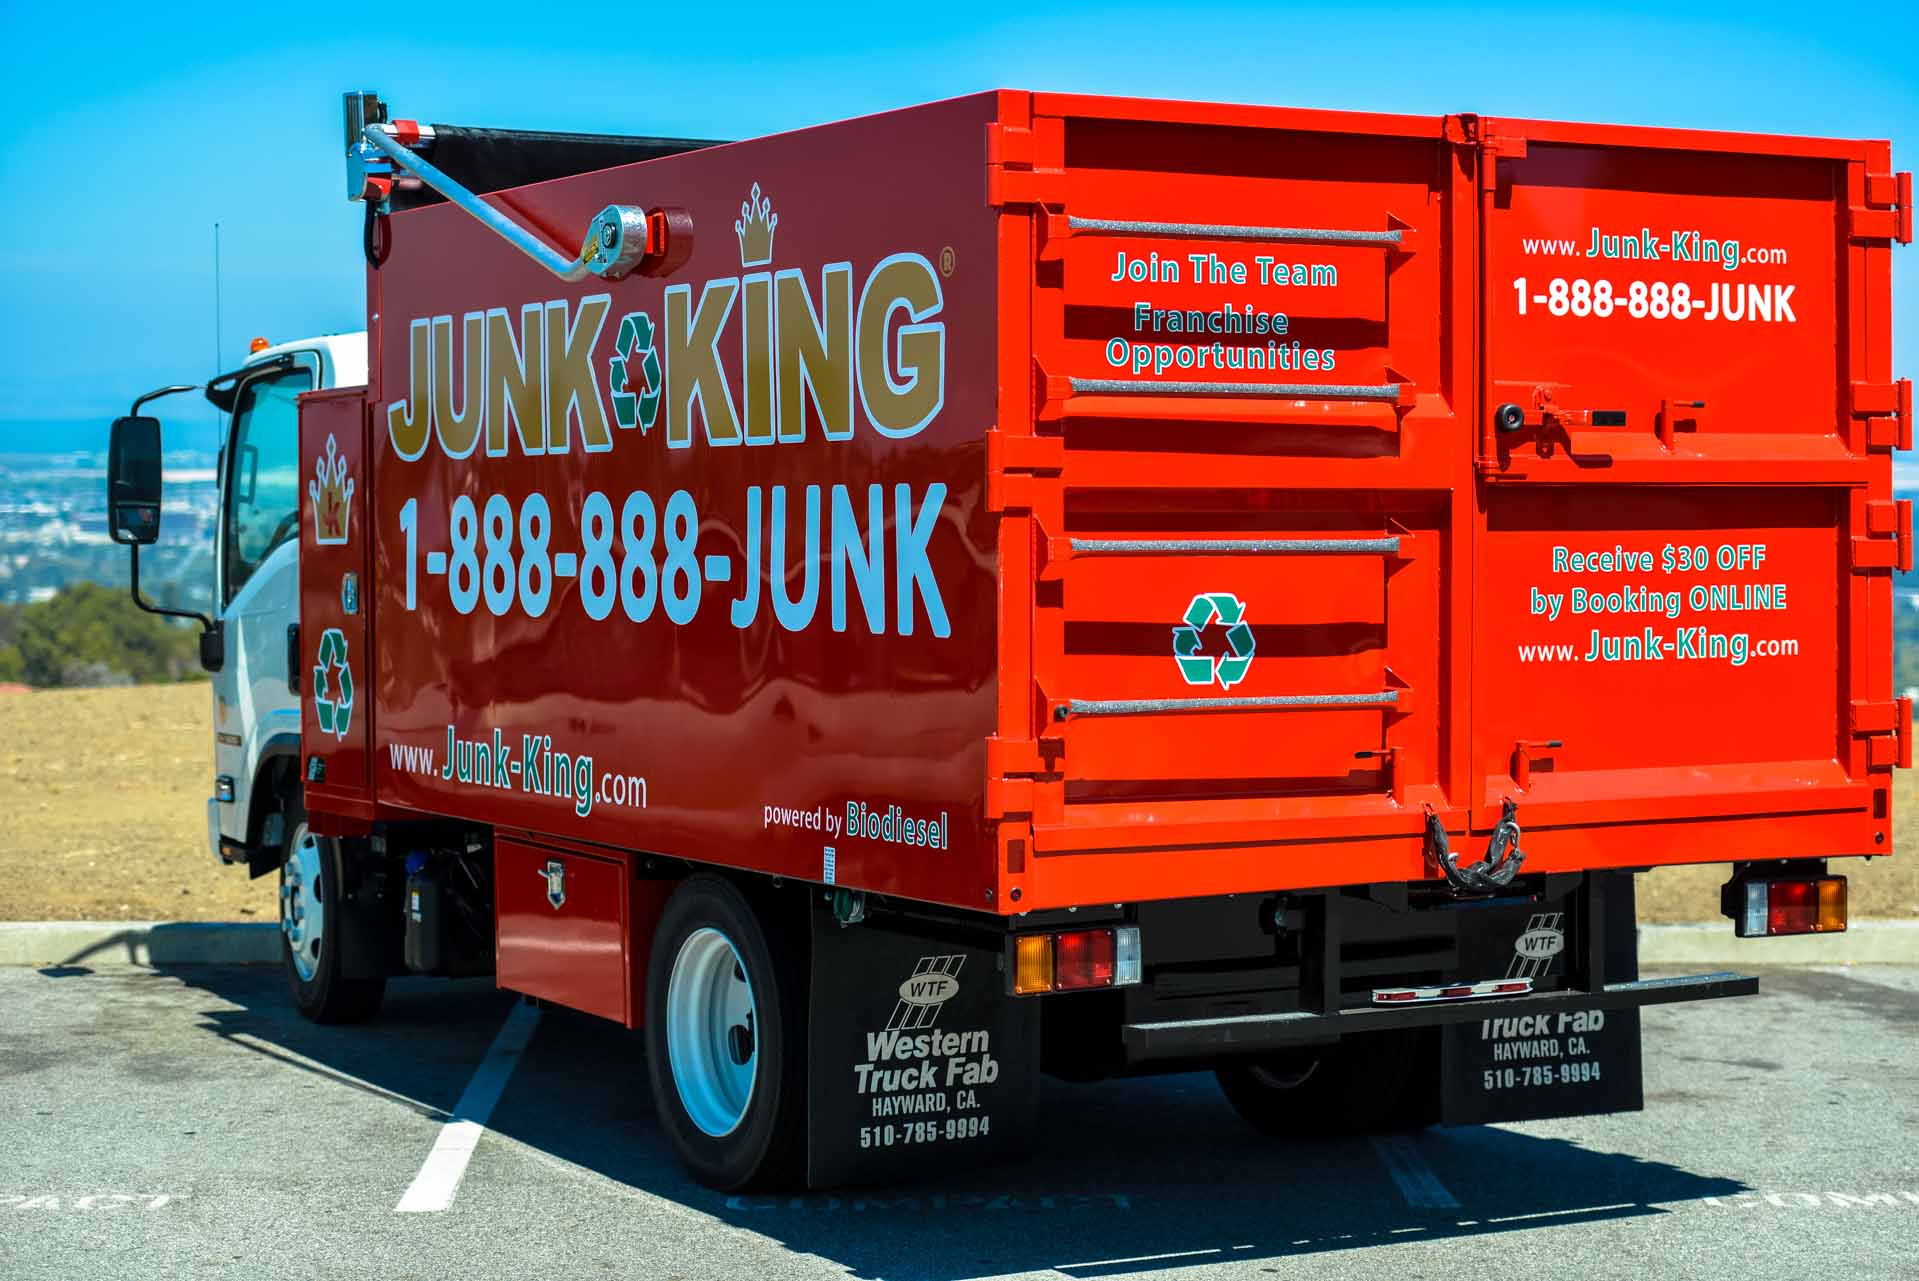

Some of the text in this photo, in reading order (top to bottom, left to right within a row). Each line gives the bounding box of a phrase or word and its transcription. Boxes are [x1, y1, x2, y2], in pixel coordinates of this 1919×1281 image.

[1111, 252, 1337, 286] Join The Team
[1513, 277, 1796, 322] 1-888-888-JUNK
[1134, 302, 1288, 334] Franchise
[387, 293, 613, 462] JUNK
[664, 253, 945, 449] KING
[1106, 337, 1335, 374] Opportunities
[399, 483, 951, 639] 1-888-888-JUNK
[1552, 544, 1766, 573] Receive $30 OFF
[1531, 584, 1786, 621] by Booking ONLINE
[764, 801, 948, 850] powered by Biodiesel
[1524, 936, 1556, 951] WTF
[910, 980, 948, 997] WTF
[867, 1028, 989, 1061] Western
[1494, 1036, 1590, 1061] HAYWARD, CA.
[854, 1053, 999, 1094] Truck Fab
[1484, 1061, 1600, 1090] 510-785-9994
[872, 1090, 980, 1117] HAYWARD, CA.
[860, 1115, 990, 1148] 510-785-9994
